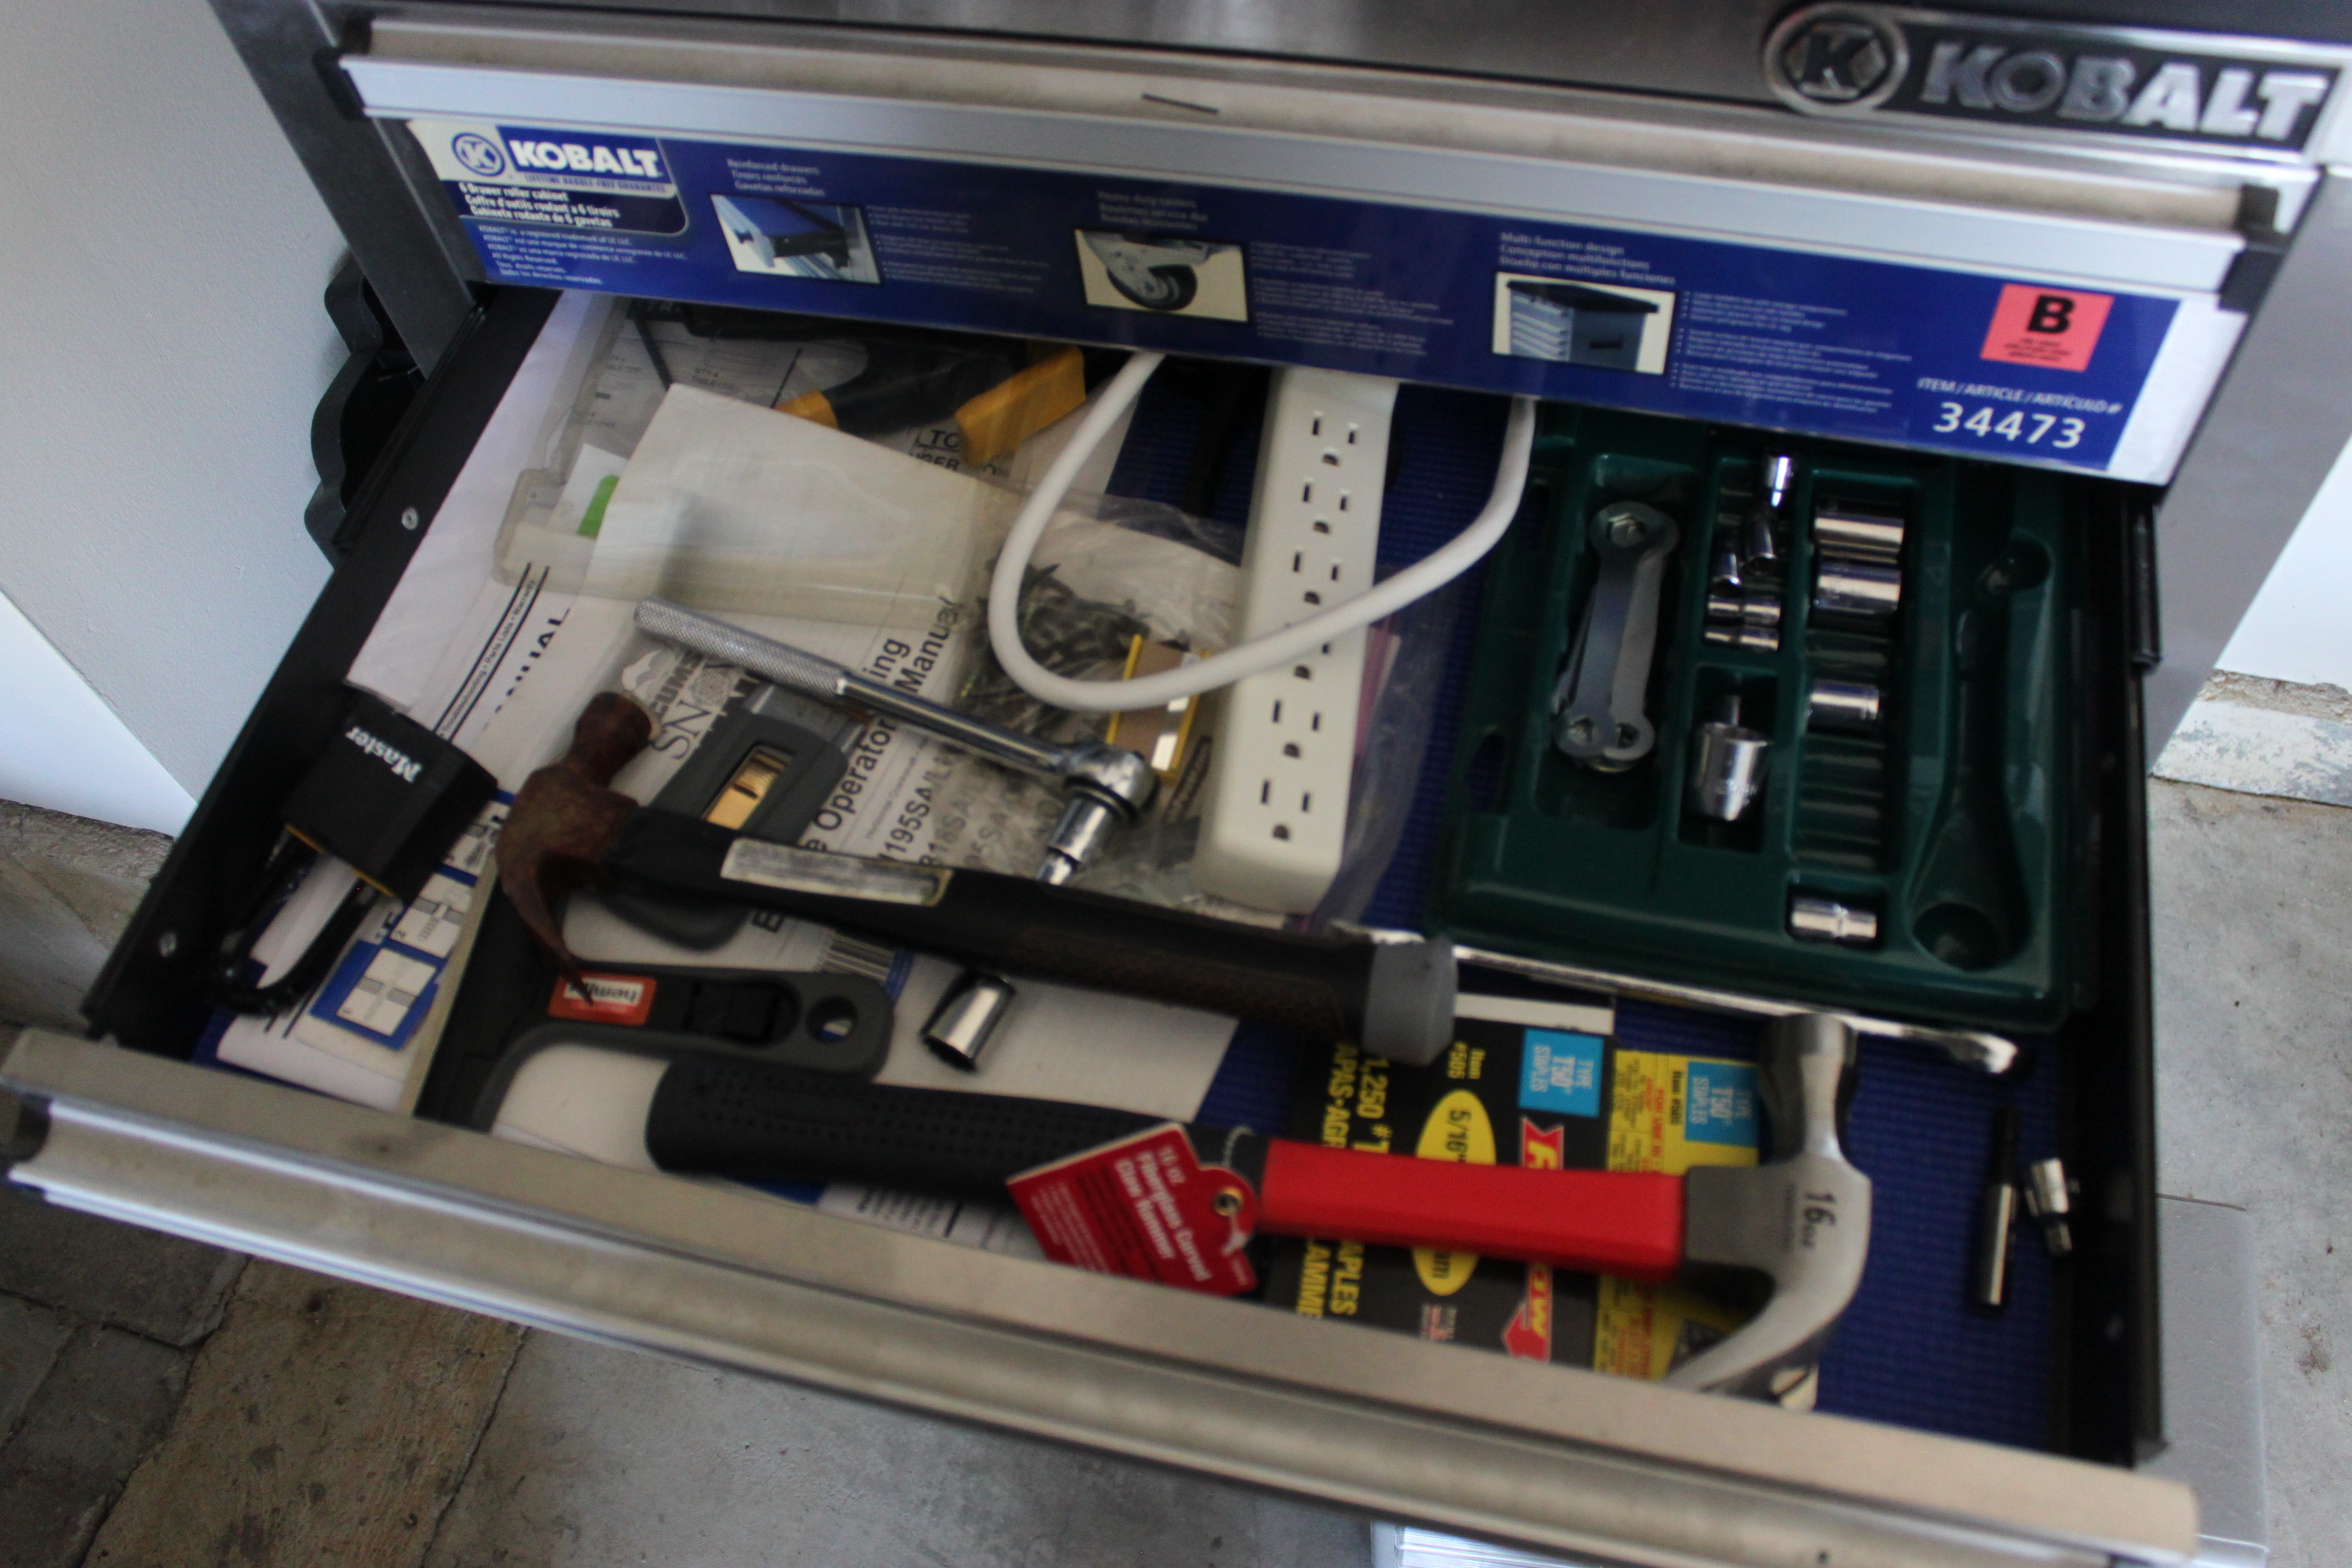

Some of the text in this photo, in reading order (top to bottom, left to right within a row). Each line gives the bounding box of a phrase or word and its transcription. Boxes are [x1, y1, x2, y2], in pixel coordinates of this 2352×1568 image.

[1922, 42, 2329, 141] KOBALT
[508, 139, 661, 178] KOBALT
[2025, 294, 2077, 334] B
[1933, 402, 2086, 449] 34473
[814, 595, 960, 833] Operator Manual
[344, 725, 425, 784] Master
[1469, 1047, 1487, 1080] Item
[1532, 1044, 1551, 1093] STAPLES
[1356, 1058, 1389, 1119] 1,250
[1691, 1077, 1709, 1124] STAPLES
[1137, 1199, 1177, 1261] Hammer
